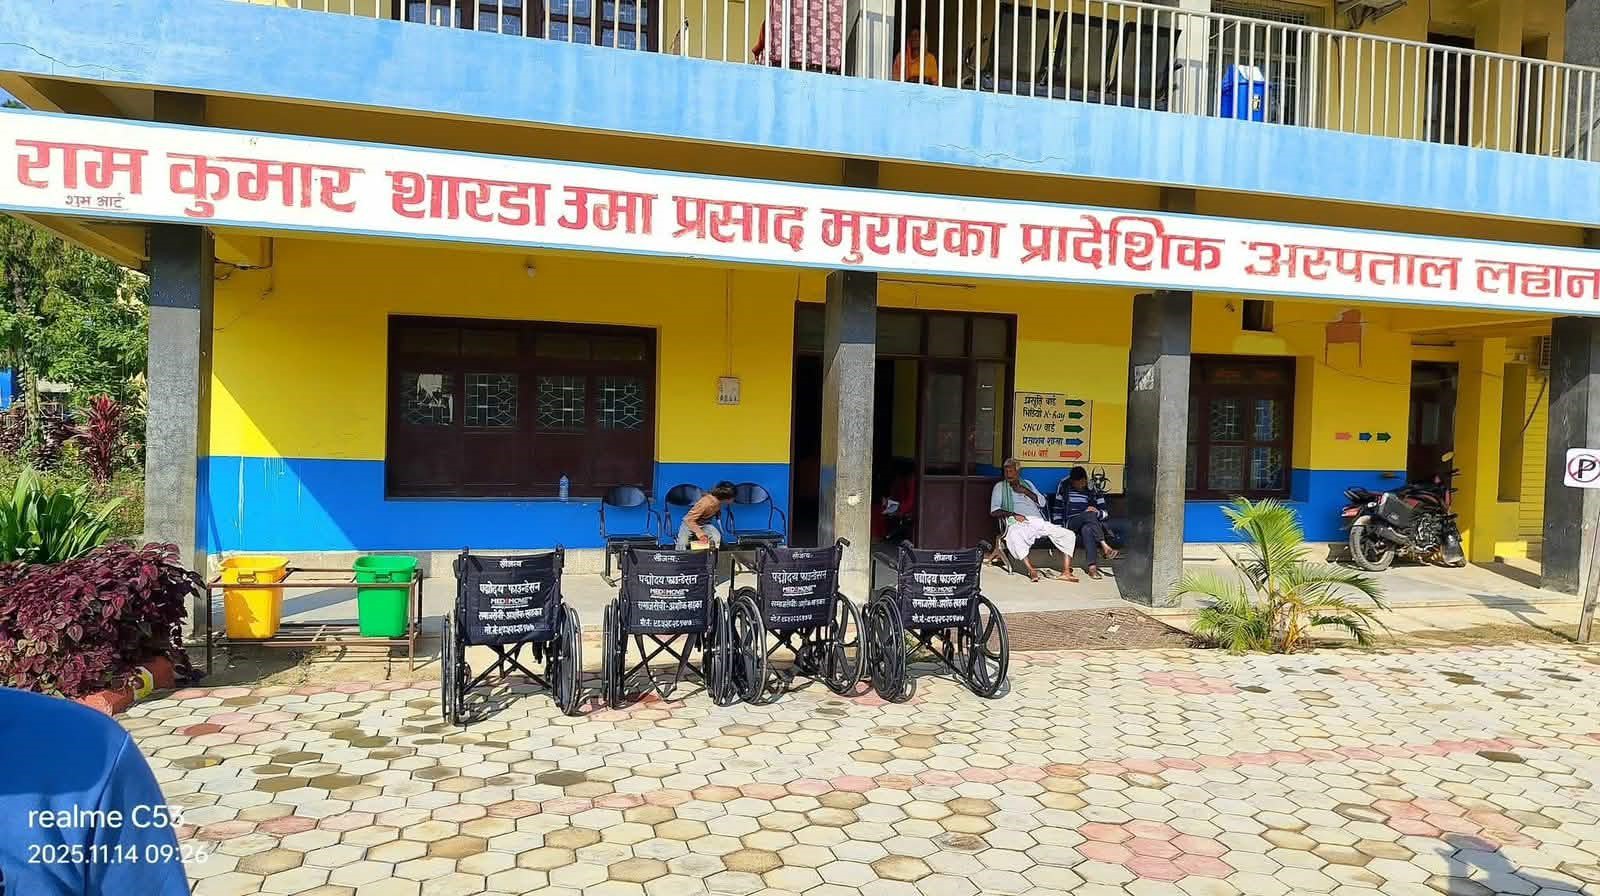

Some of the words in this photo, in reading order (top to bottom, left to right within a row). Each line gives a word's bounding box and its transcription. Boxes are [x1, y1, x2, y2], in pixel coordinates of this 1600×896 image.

[16, 139, 148, 194] राम
[166, 151, 366, 218] कुमार
[384, 170, 552, 227] शारडा
[556, 185, 658, 235] उमा
[671, 196, 808, 252] प्रसाद
[820, 208, 1007, 264] मुरारका
[1019, 215, 1225, 272] प्रादेशिक
[1240, 240, 1463, 291] अस्पताल
[1474, 259, 1600, 300] लहान
[1022, 423, 1041, 432] SNCU
[1578, 459, 1596, 478] P
